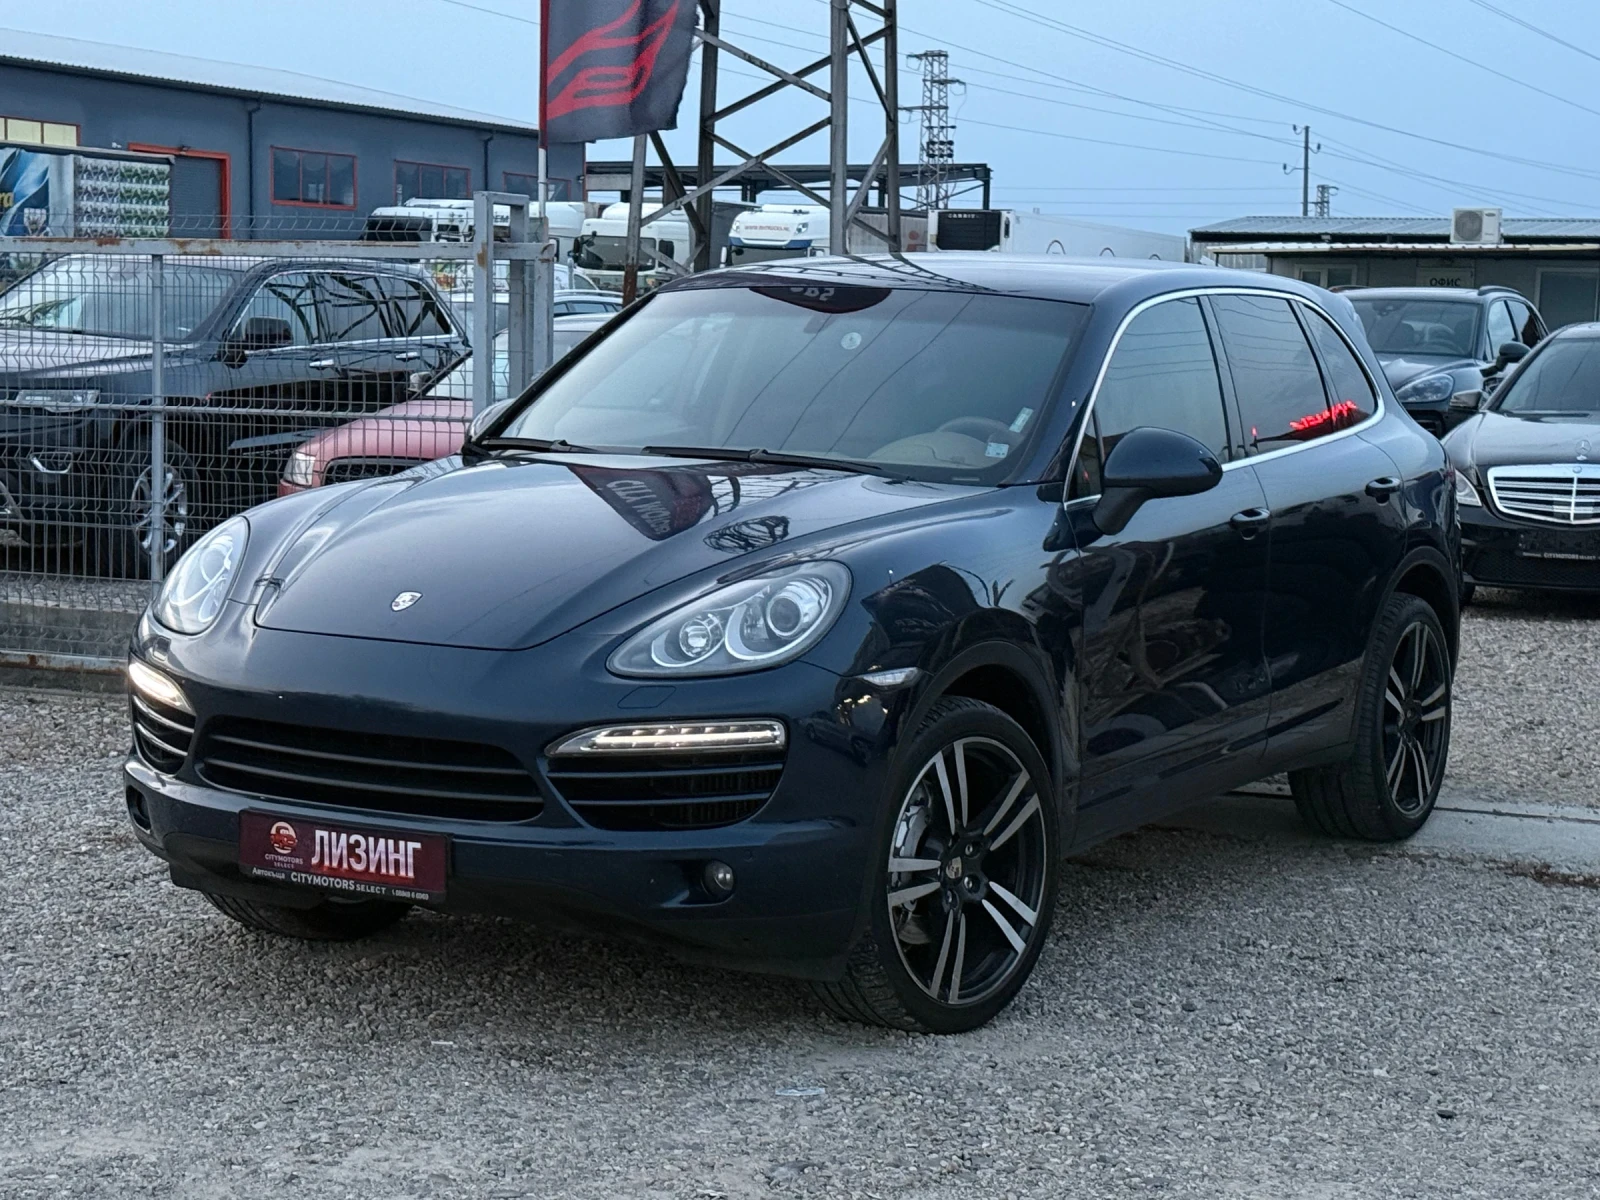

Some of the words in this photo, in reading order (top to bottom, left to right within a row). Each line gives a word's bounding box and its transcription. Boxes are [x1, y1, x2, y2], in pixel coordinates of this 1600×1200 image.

[1429, 277, 1461, 287] ОФИС
[264, 853, 304, 865] CITYMOTORS
[311, 829, 421, 879] ЛИЗИНГ
[290, 871, 355, 891] CITYMOTORS
[356, 883, 386, 895] SELECT
